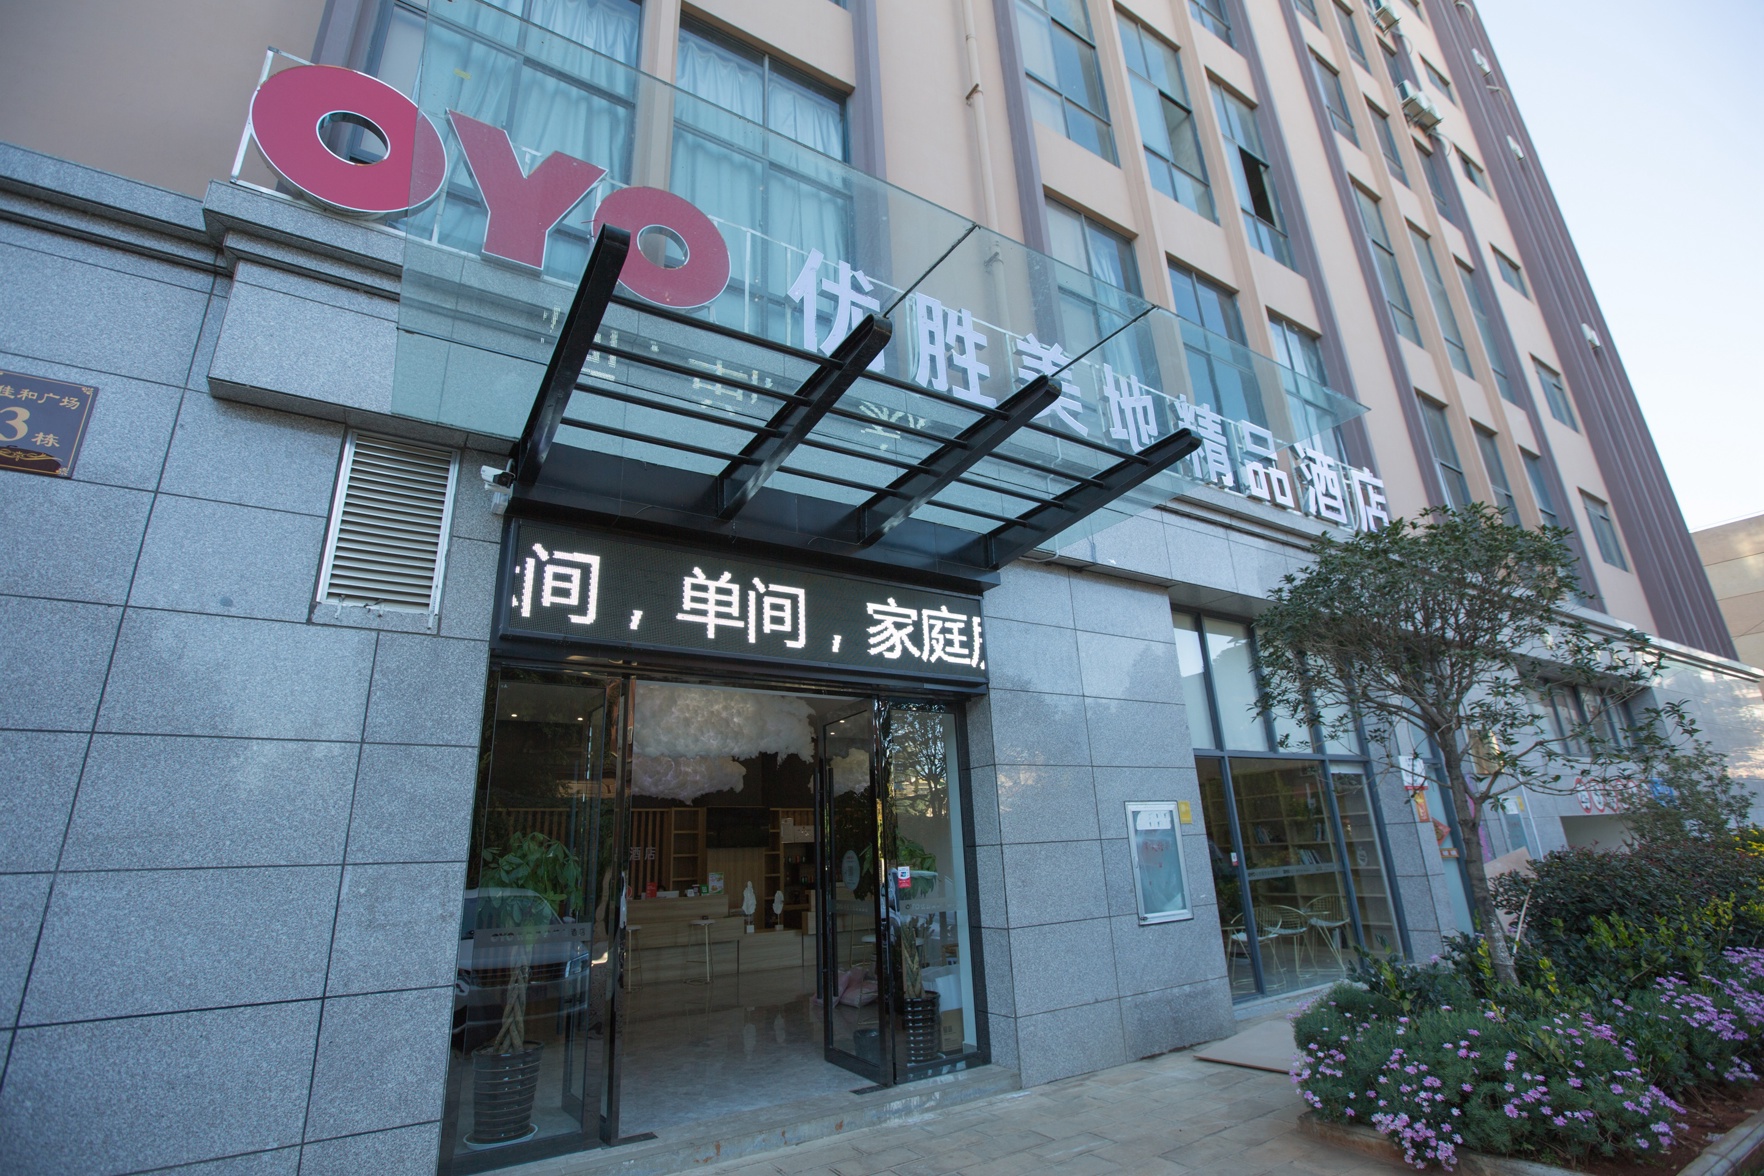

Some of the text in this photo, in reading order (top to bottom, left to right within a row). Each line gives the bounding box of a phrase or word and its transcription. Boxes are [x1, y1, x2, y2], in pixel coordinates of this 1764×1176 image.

[250, 64, 731, 311] OYO
[0, 384, 81, 411] 佳和广场
[786, 247, 1390, 534] 优胜美地精品酒店
